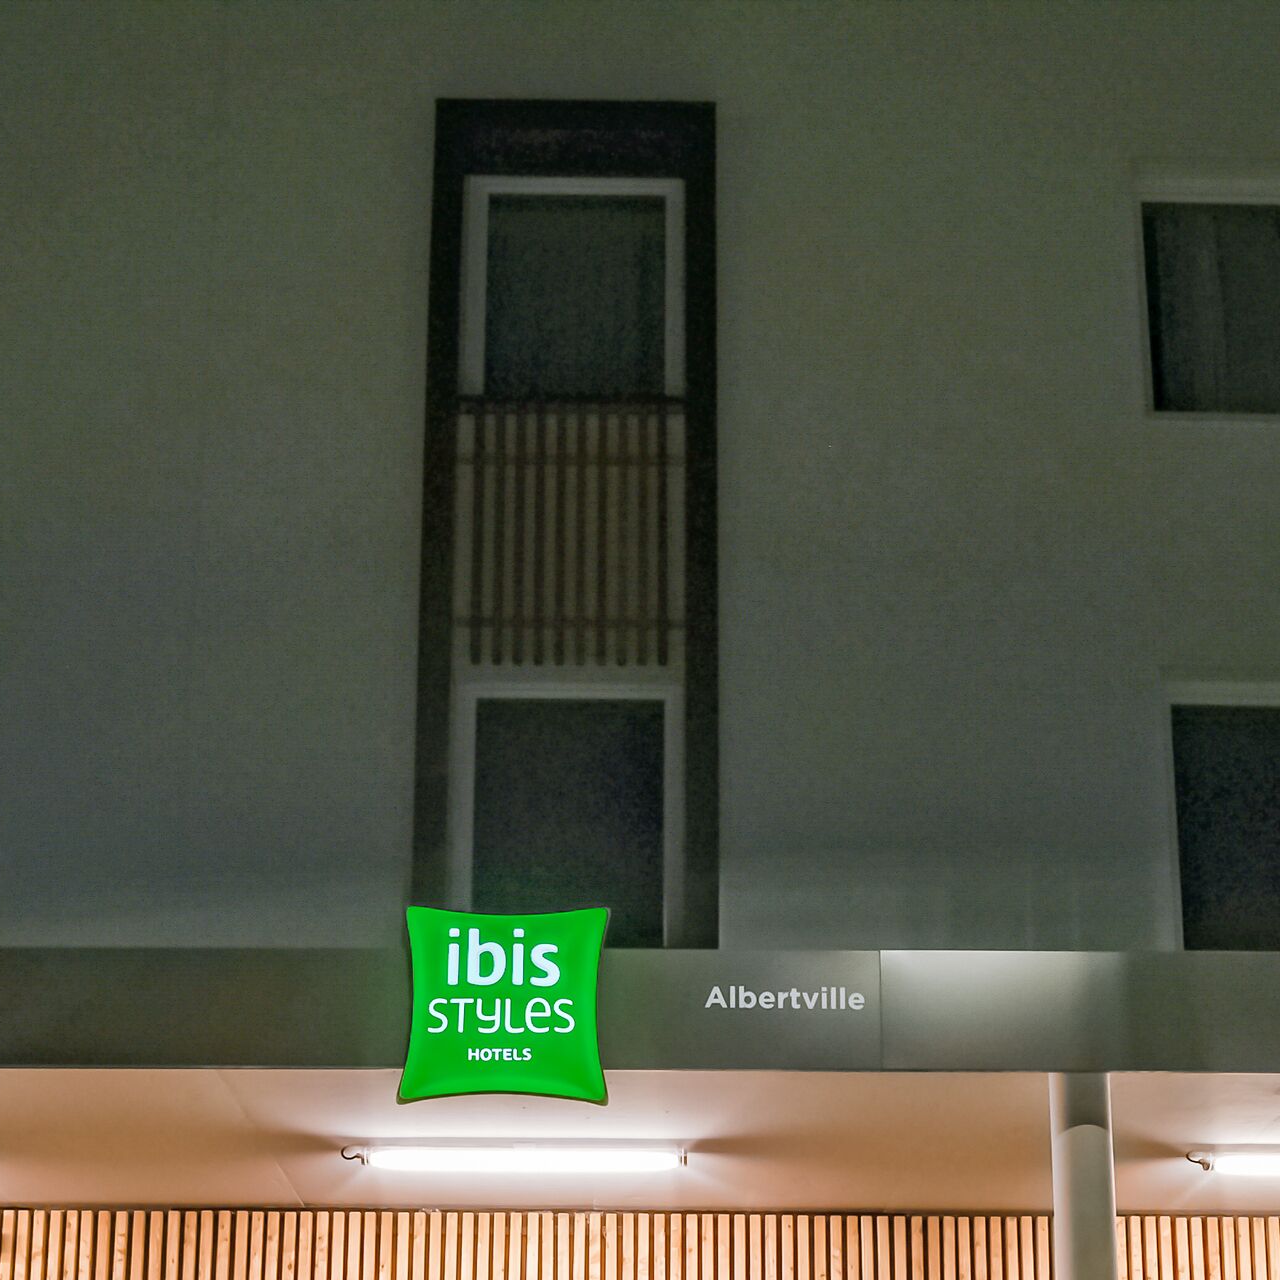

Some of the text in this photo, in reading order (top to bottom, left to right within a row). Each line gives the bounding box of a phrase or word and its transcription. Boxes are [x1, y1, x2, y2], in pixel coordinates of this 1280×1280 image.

[447, 928, 561, 987] ibis
[705, 986, 866, 1010] Albertville
[427, 997, 576, 1034] STYLES
[467, 1048, 532, 1061] HOTELS
